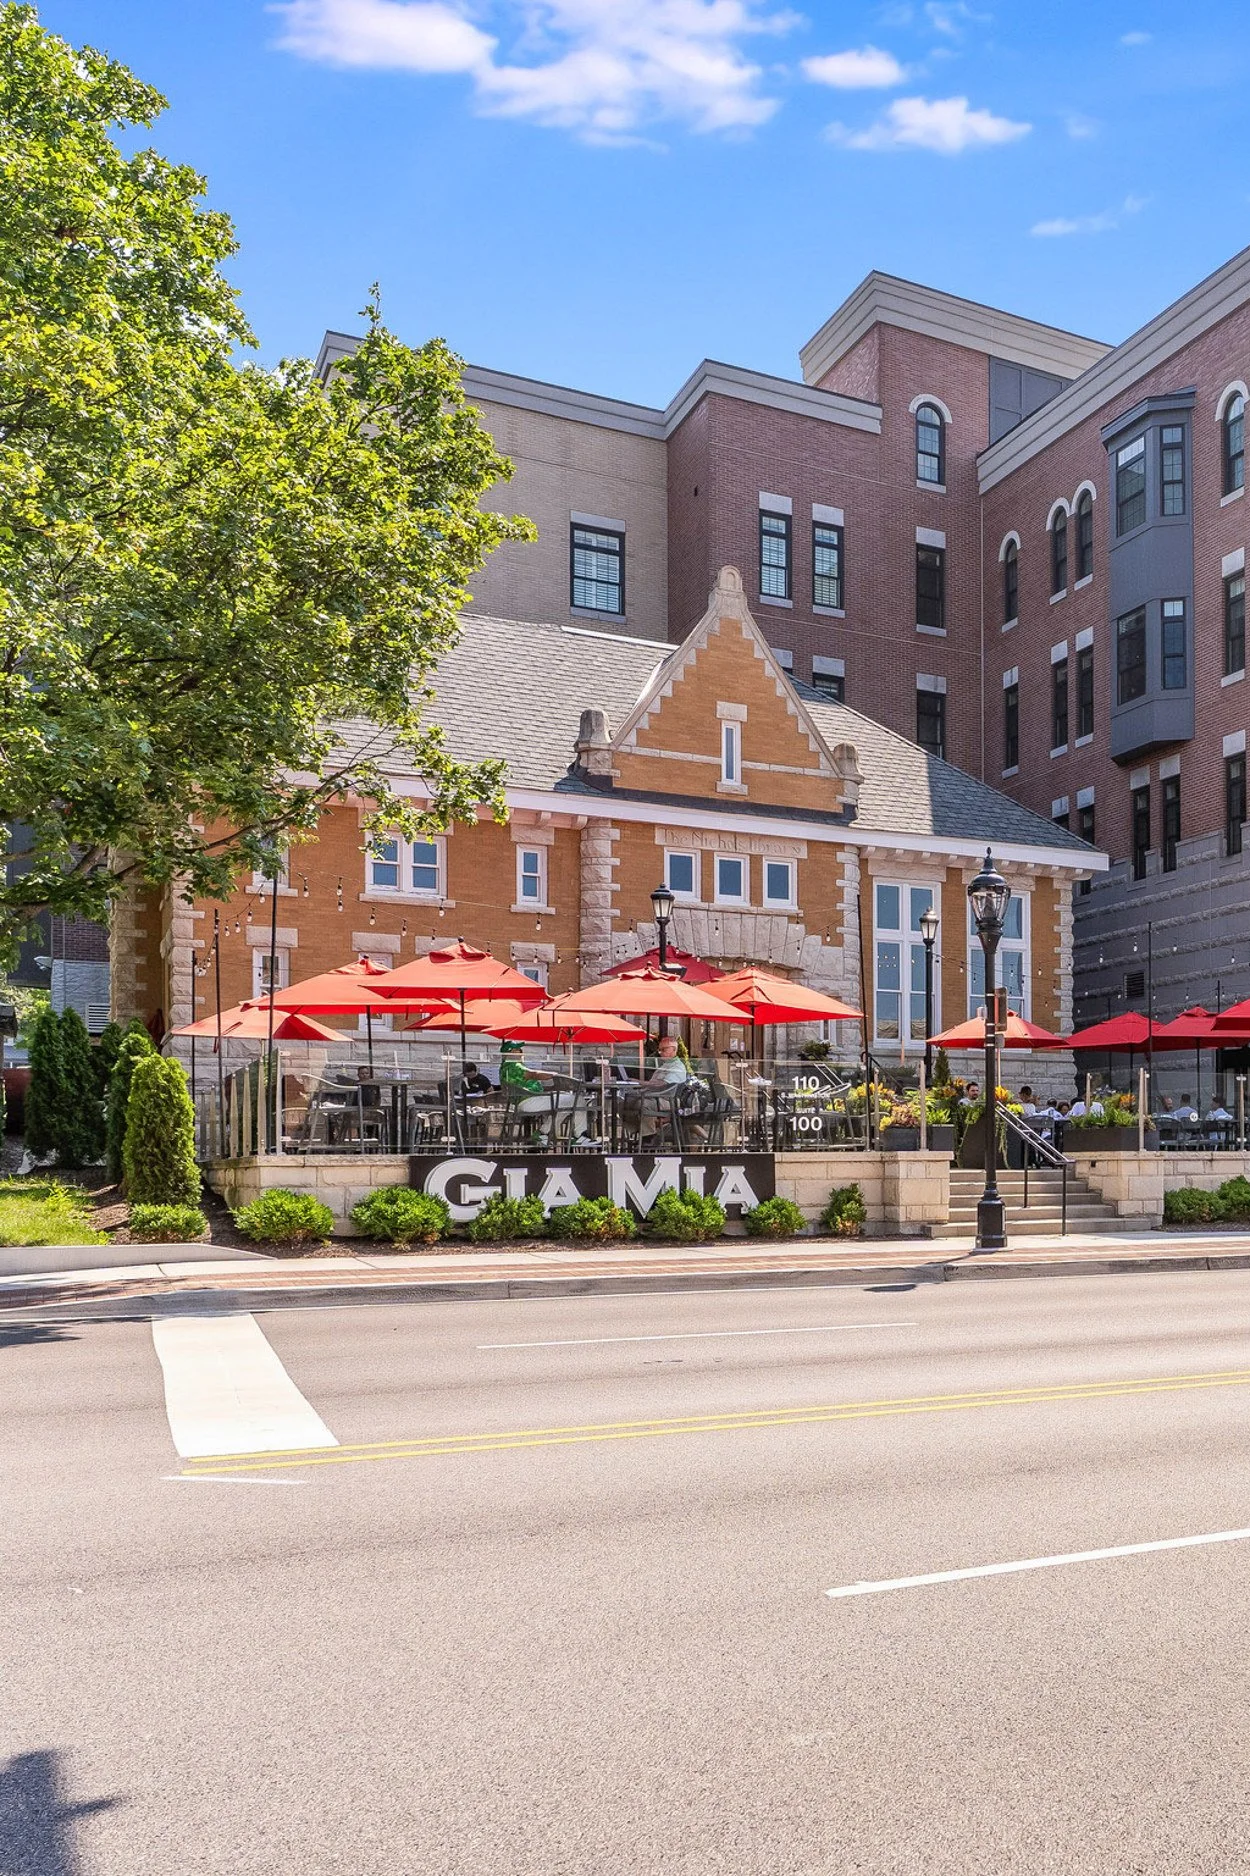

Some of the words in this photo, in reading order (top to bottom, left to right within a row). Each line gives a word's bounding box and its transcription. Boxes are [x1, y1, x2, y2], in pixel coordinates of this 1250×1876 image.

[662, 828, 688, 846] The
[691, 831, 747, 852] Nichols
[791, 1076, 820, 1091] 110
[789, 1116, 823, 1131] 100
[423, 1157, 583, 1223] GIA
[604, 1156, 761, 1220] MIA
